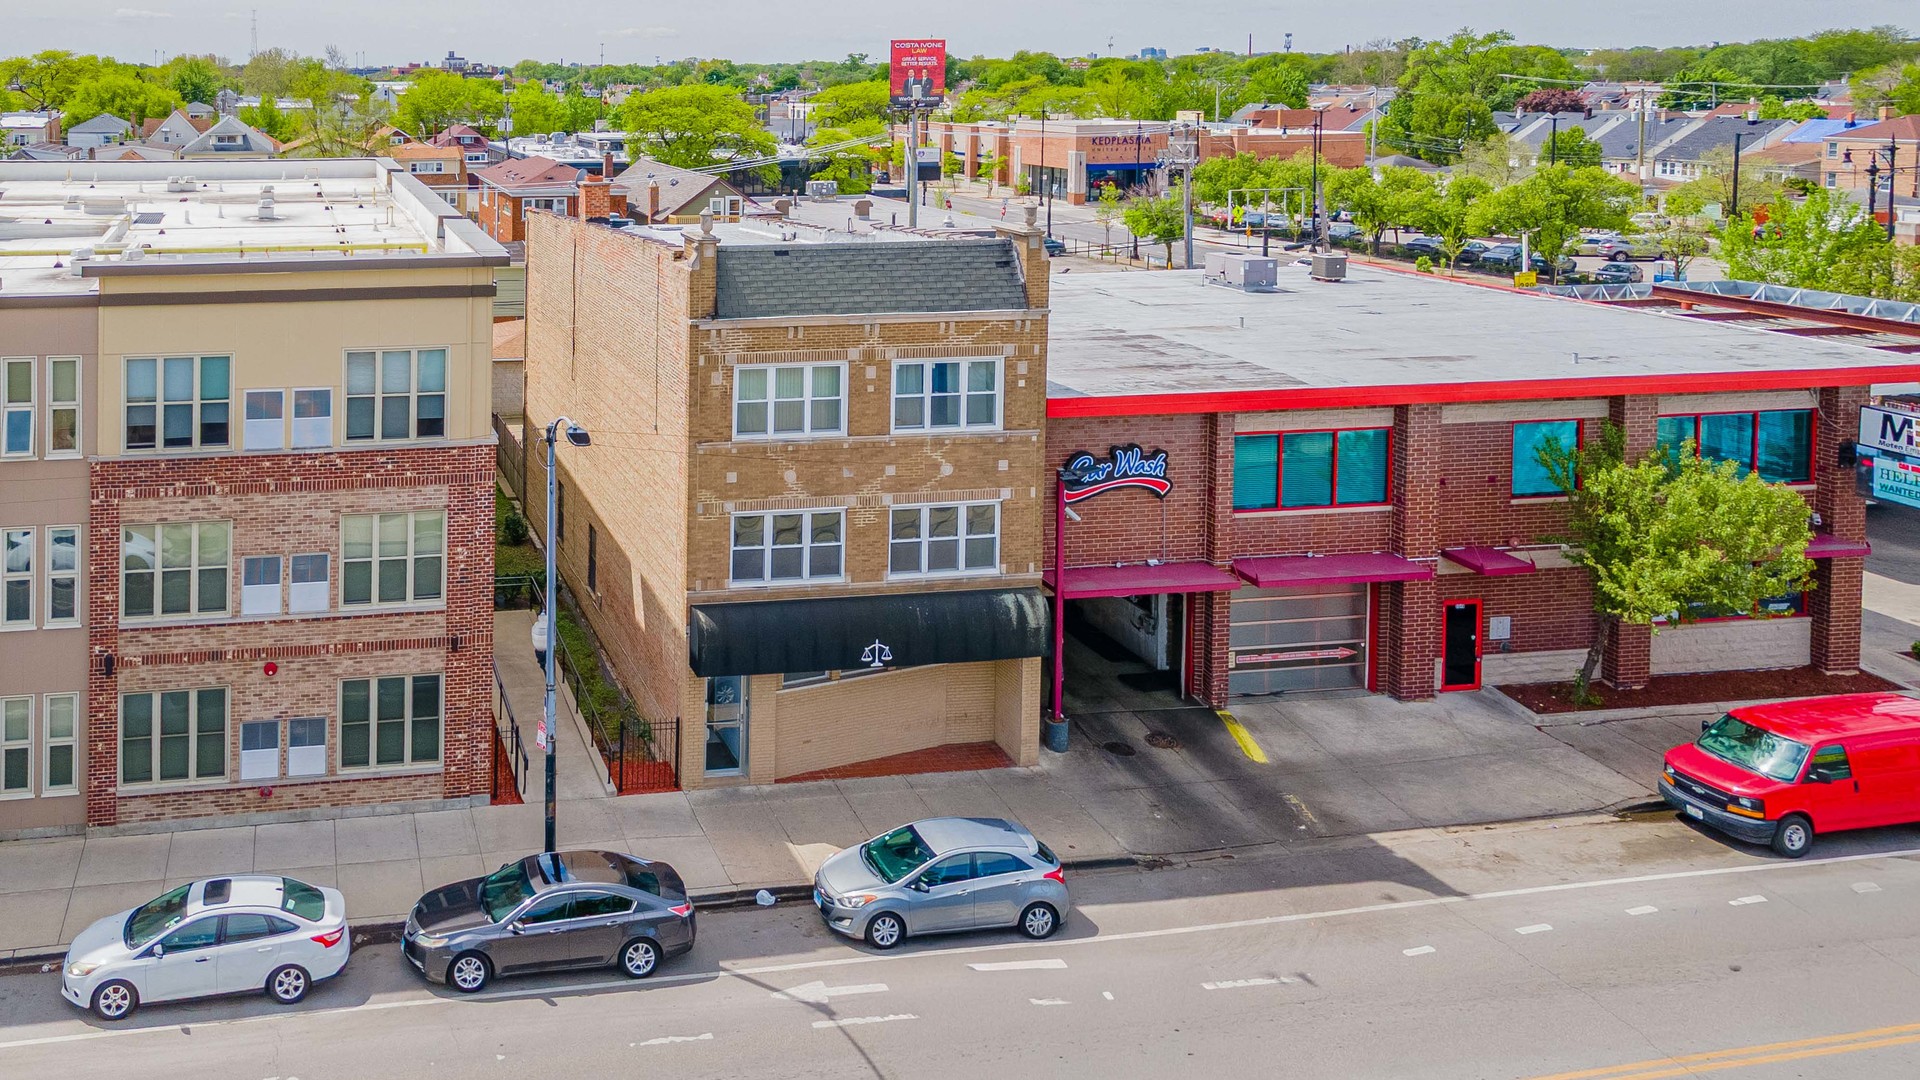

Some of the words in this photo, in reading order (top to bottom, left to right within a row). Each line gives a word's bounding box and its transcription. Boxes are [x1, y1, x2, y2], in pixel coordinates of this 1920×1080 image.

[1878, 439, 1903, 450] Moten
[1114, 447, 1167, 478] Wash
[1879, 482, 1920, 499] WANTED
